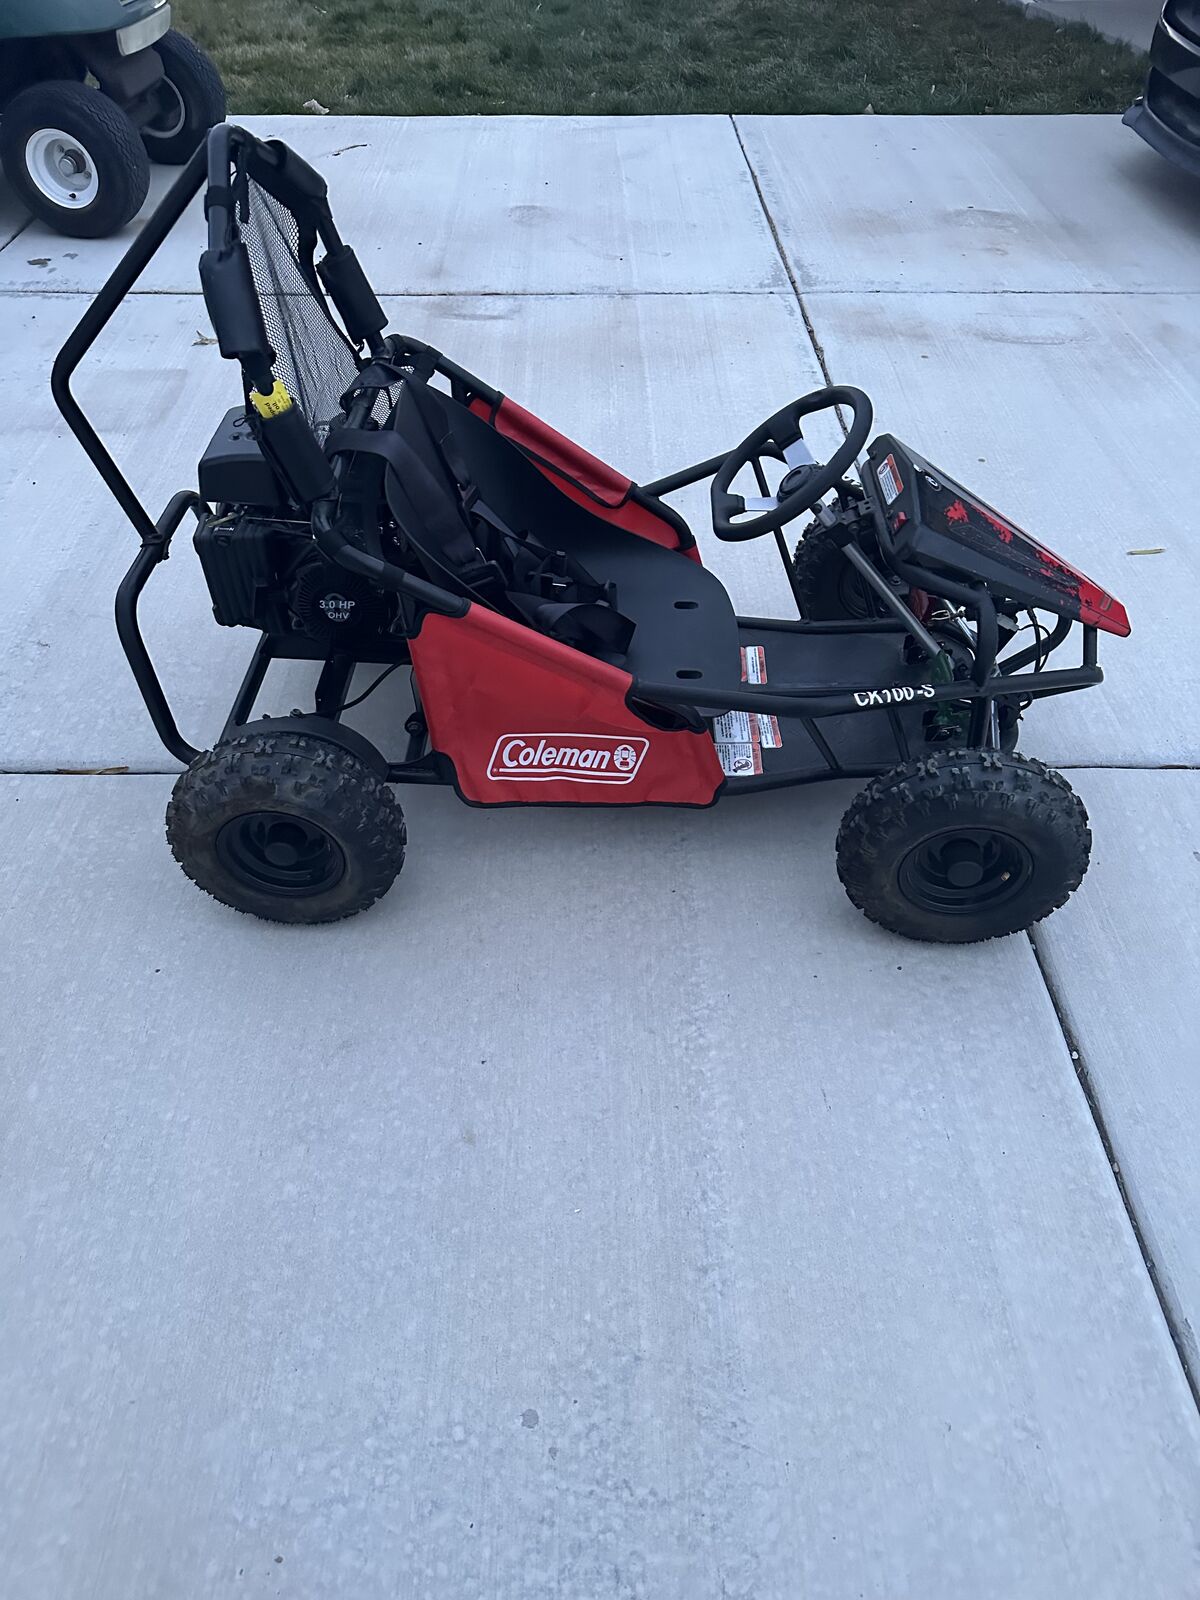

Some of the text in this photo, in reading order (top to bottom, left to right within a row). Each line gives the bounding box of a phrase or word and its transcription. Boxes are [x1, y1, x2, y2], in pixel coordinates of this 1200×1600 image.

[319, 600, 356, 609] 3.0 HP
[327, 611, 349, 619] OHV
[853, 684, 935, 707] CK100-S
[502, 739, 611, 769] Coleman
